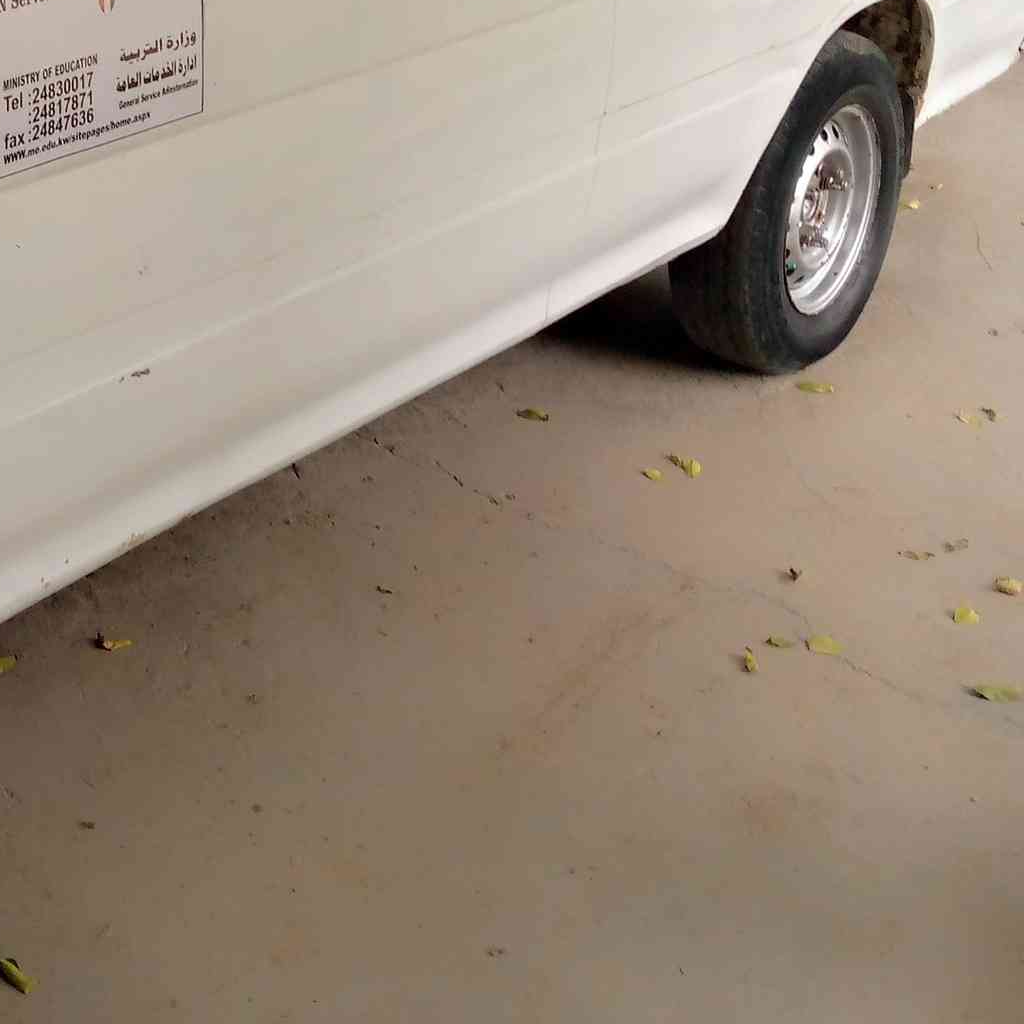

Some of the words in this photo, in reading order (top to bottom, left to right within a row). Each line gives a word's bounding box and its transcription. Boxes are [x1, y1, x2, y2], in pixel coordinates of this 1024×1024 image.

[120, 37, 163, 64] التربية
[166, 30, 197, 51] وزارة
[2, 70, 40, 90] MINISTRY
[42, 66, 53, 80] OF
[55, 53, 98, 76] EDUCATION
[116, 71, 142, 93] العامة
[143, 60, 177, 84] الخدمات
[141, 90, 160, 103] Service
